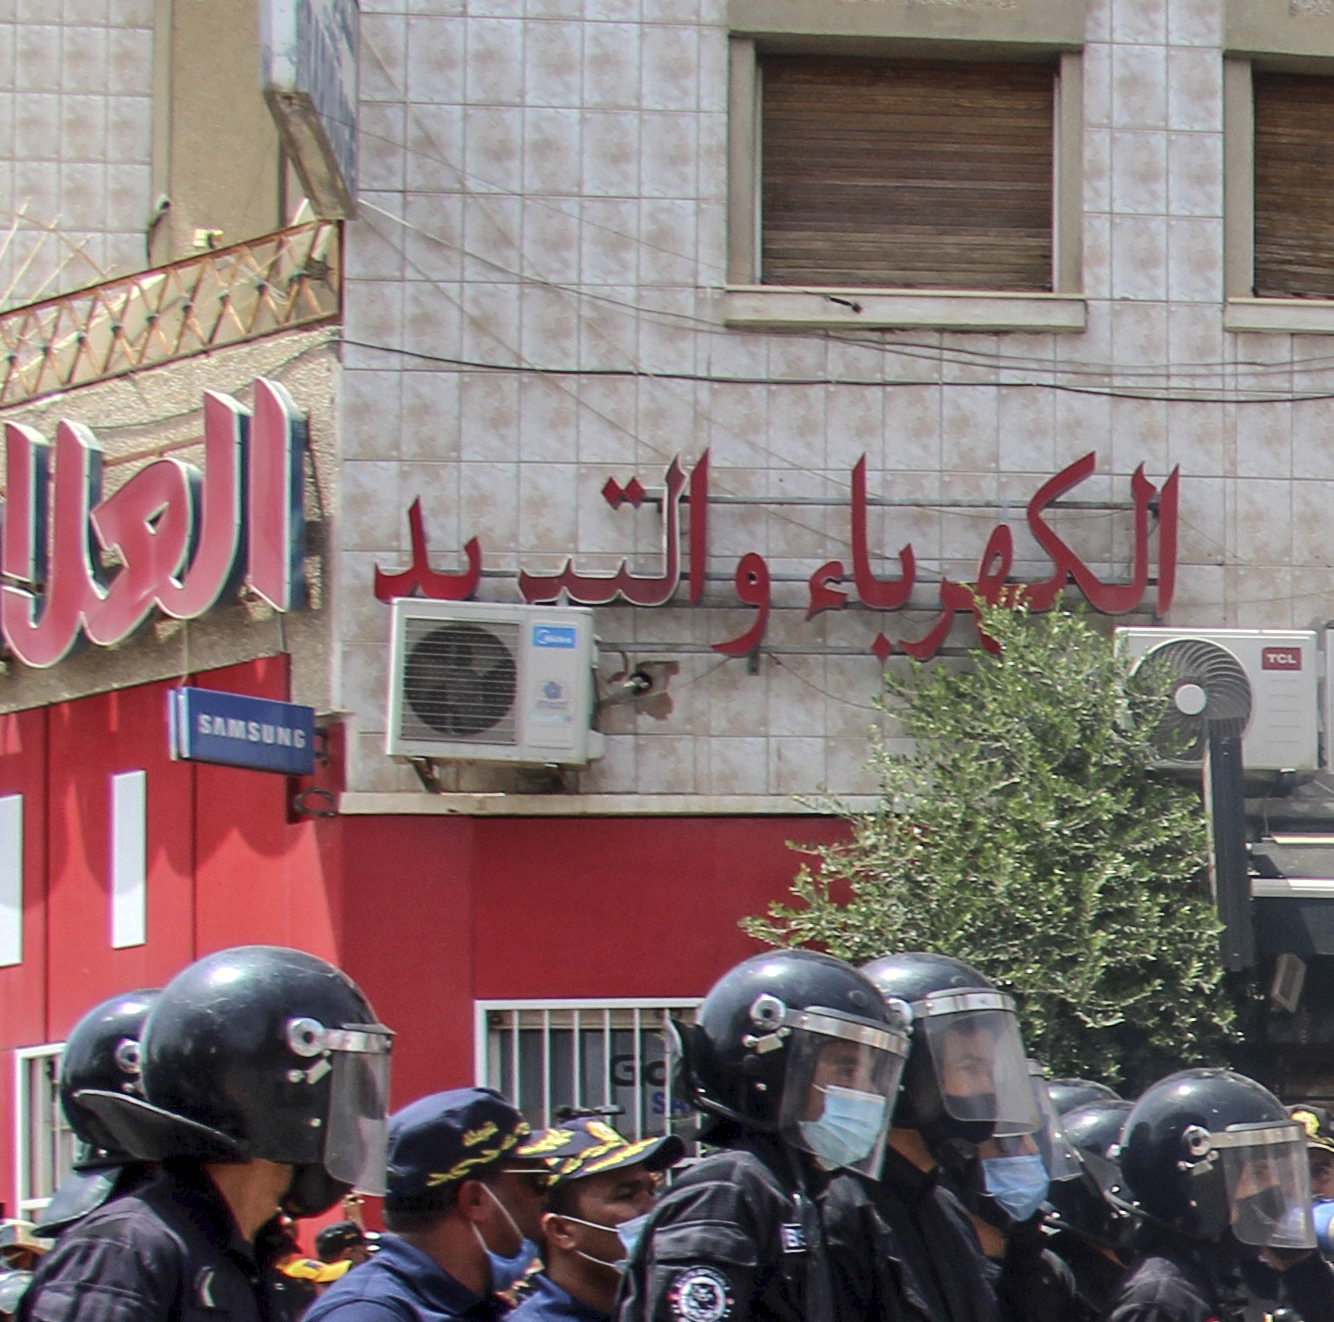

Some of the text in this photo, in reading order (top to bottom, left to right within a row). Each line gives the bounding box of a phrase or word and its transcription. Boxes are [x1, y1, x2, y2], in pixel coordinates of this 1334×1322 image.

[804, 450, 1180, 664] الكهرباء
[1267, 653, 1297, 665] TCL
[198, 714, 307, 749] SAMSUNG
